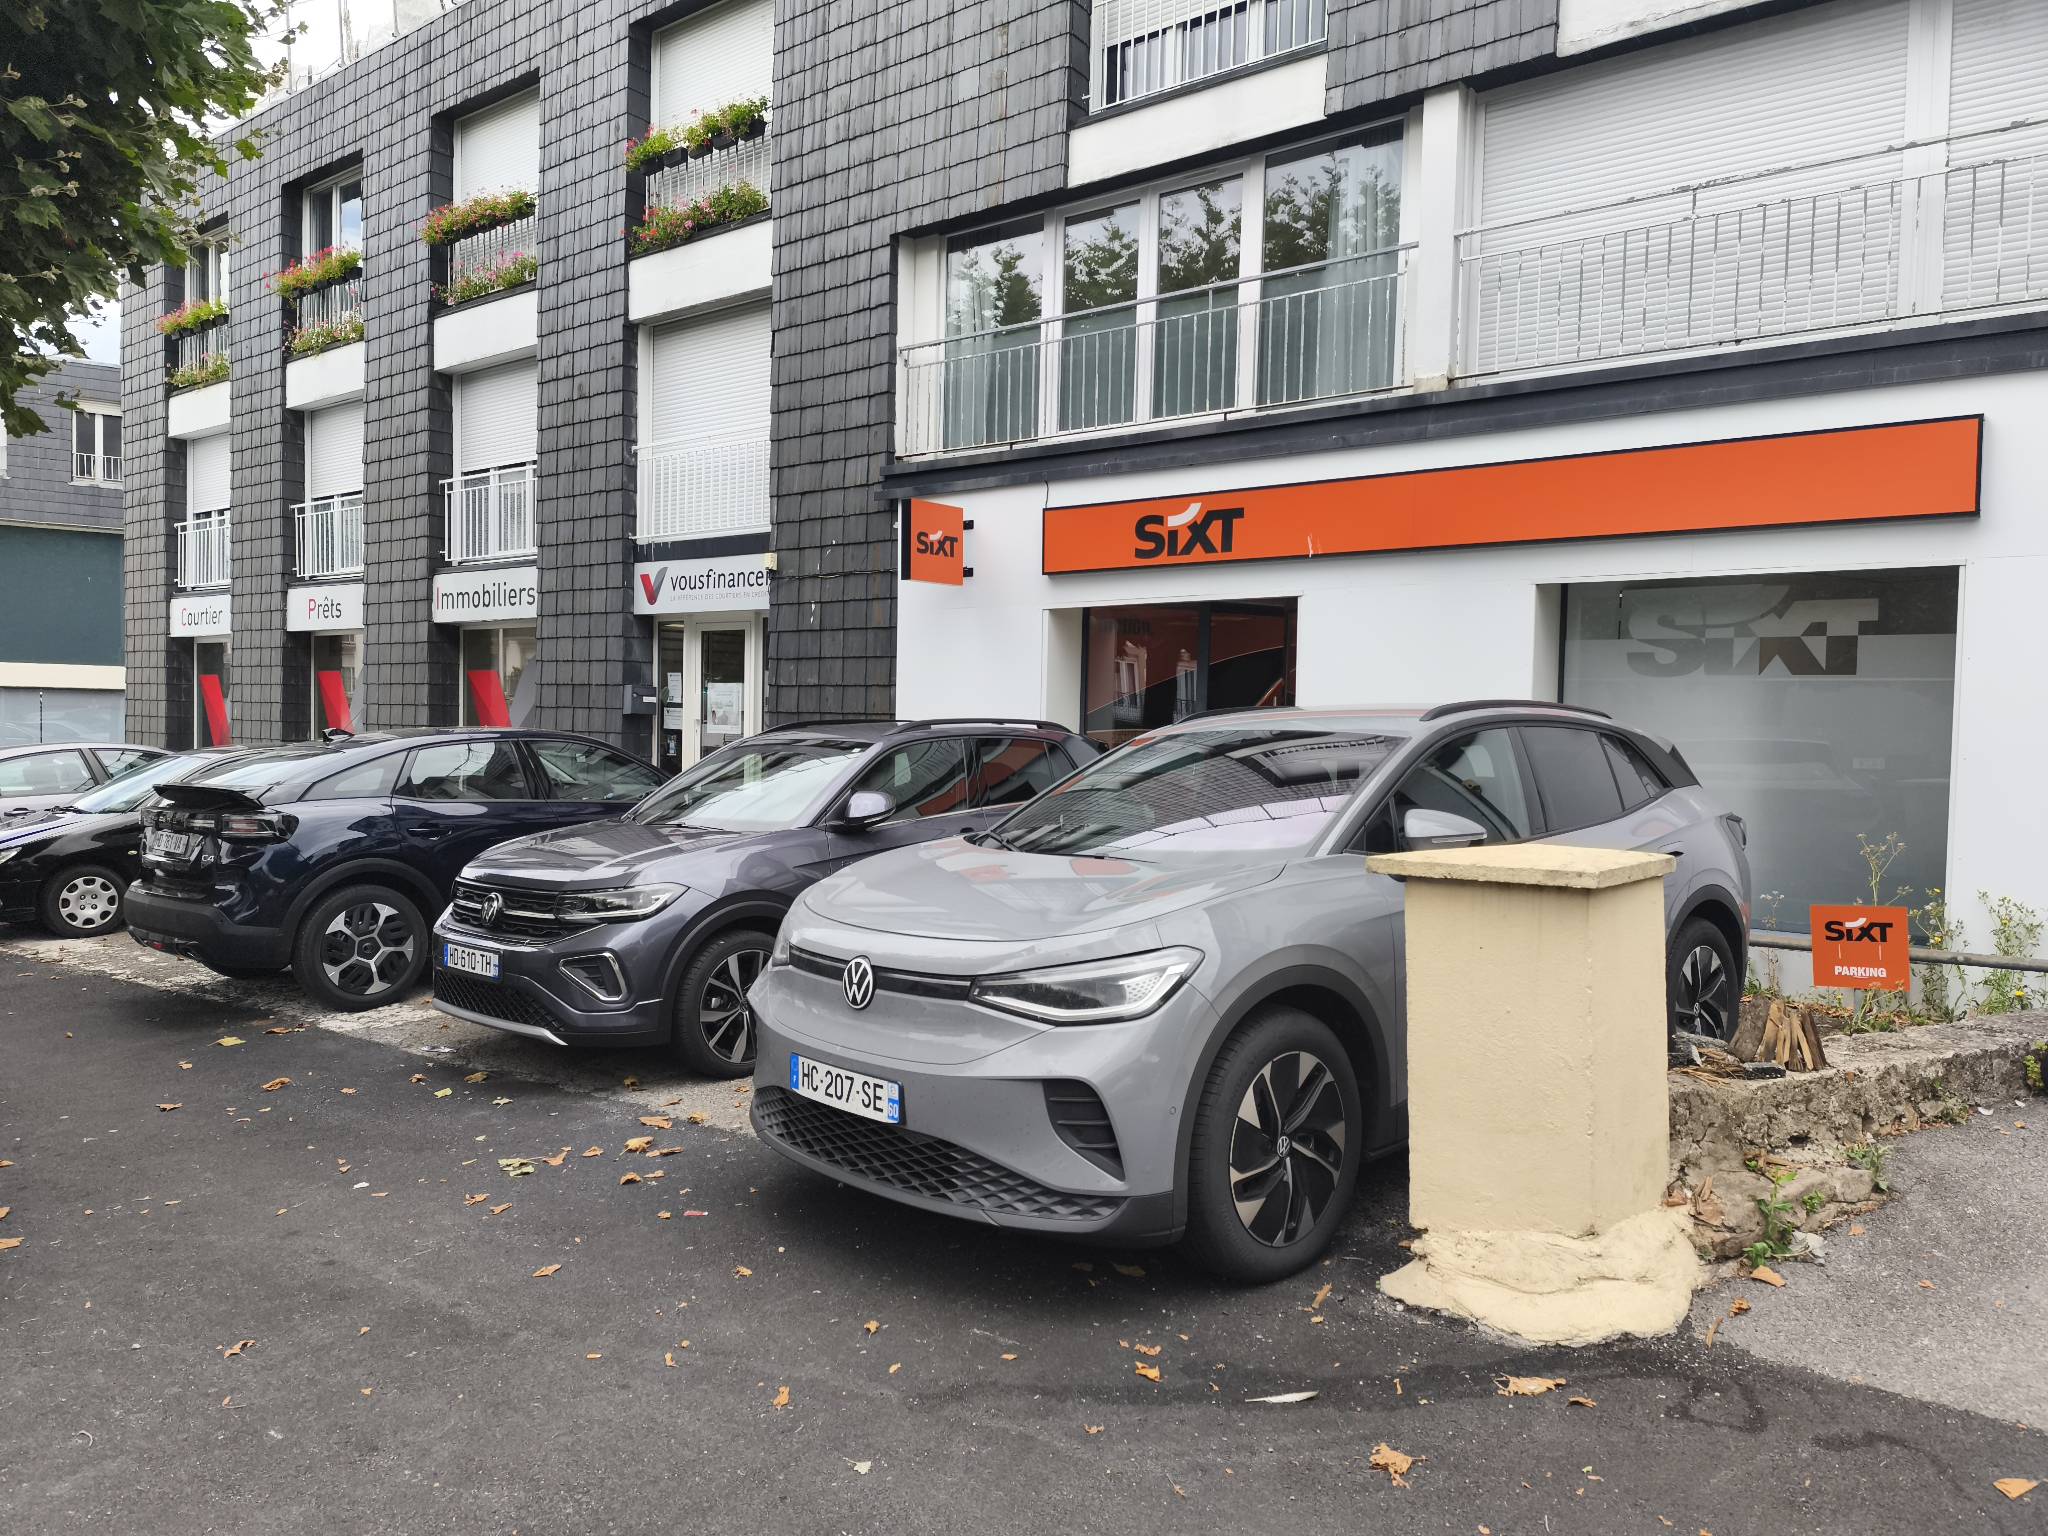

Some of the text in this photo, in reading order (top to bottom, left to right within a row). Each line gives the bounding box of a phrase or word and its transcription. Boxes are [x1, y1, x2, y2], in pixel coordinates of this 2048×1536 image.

[436, 581, 536, 610] Immobiliers
[181, 605, 223, 627] Courtier
[308, 596, 342, 621] Prêts
[201, 854, 215, 862] C4
[1834, 965, 1887, 978] PARKING
